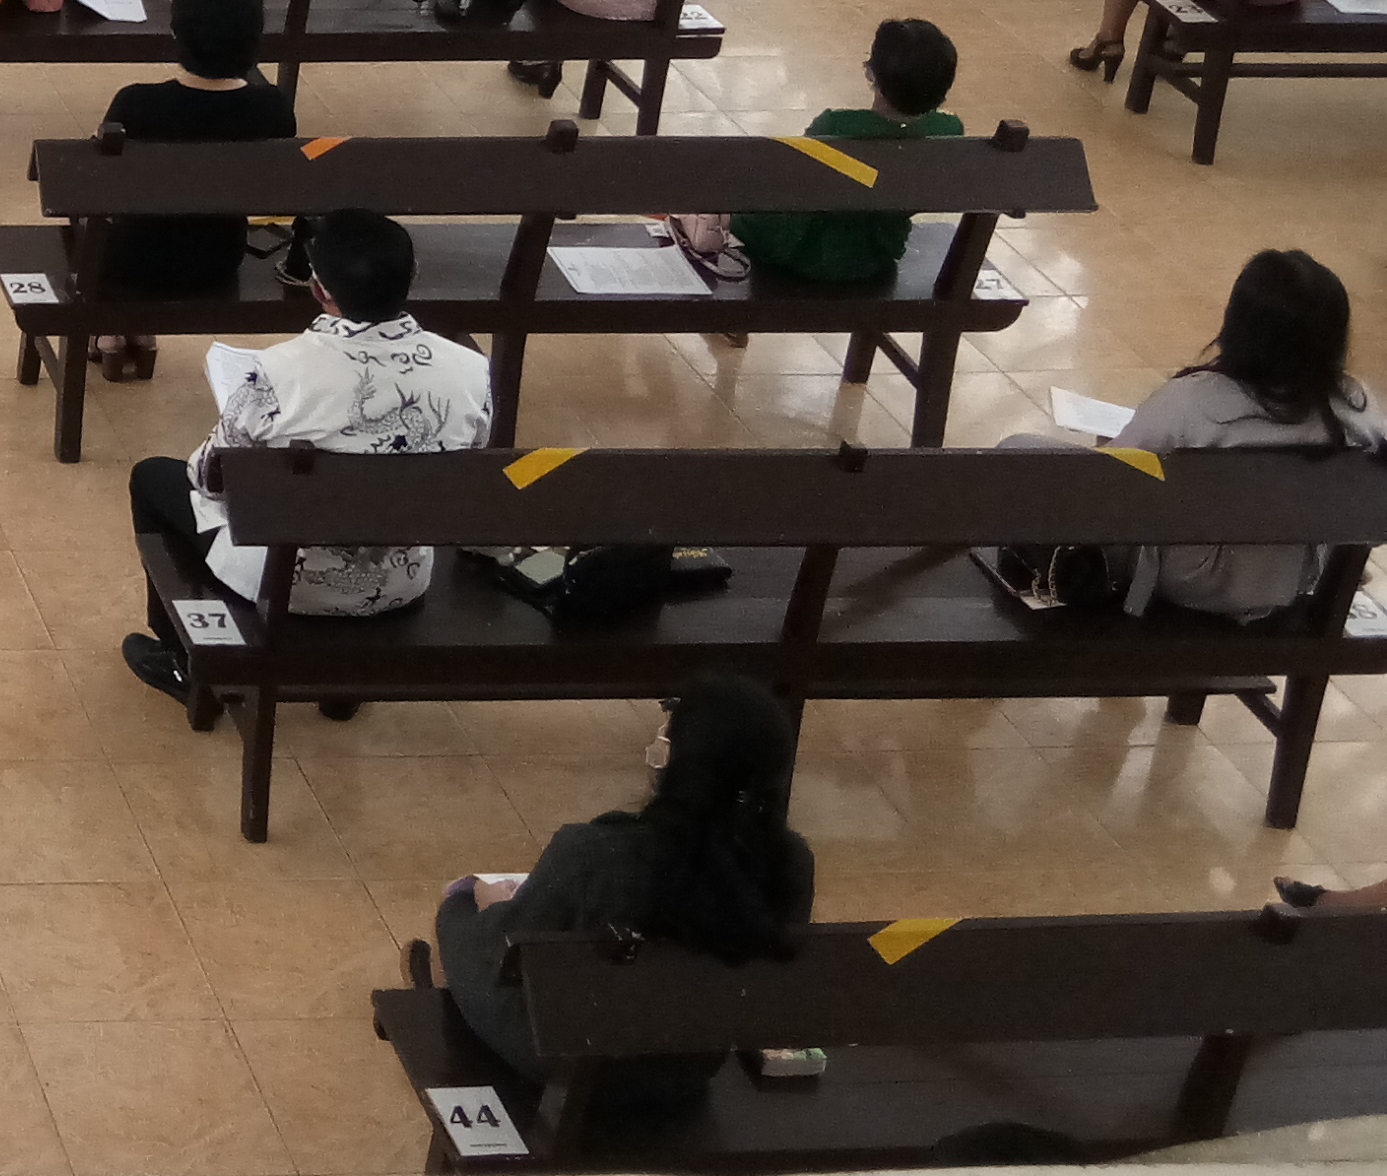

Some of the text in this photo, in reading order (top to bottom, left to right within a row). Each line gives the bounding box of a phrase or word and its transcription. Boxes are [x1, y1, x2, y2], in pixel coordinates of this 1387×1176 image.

[10, 281, 47, 295] 28
[976, 278, 1005, 291] 27
[186, 612, 227, 629] 37
[449, 1104, 502, 1129] 44
